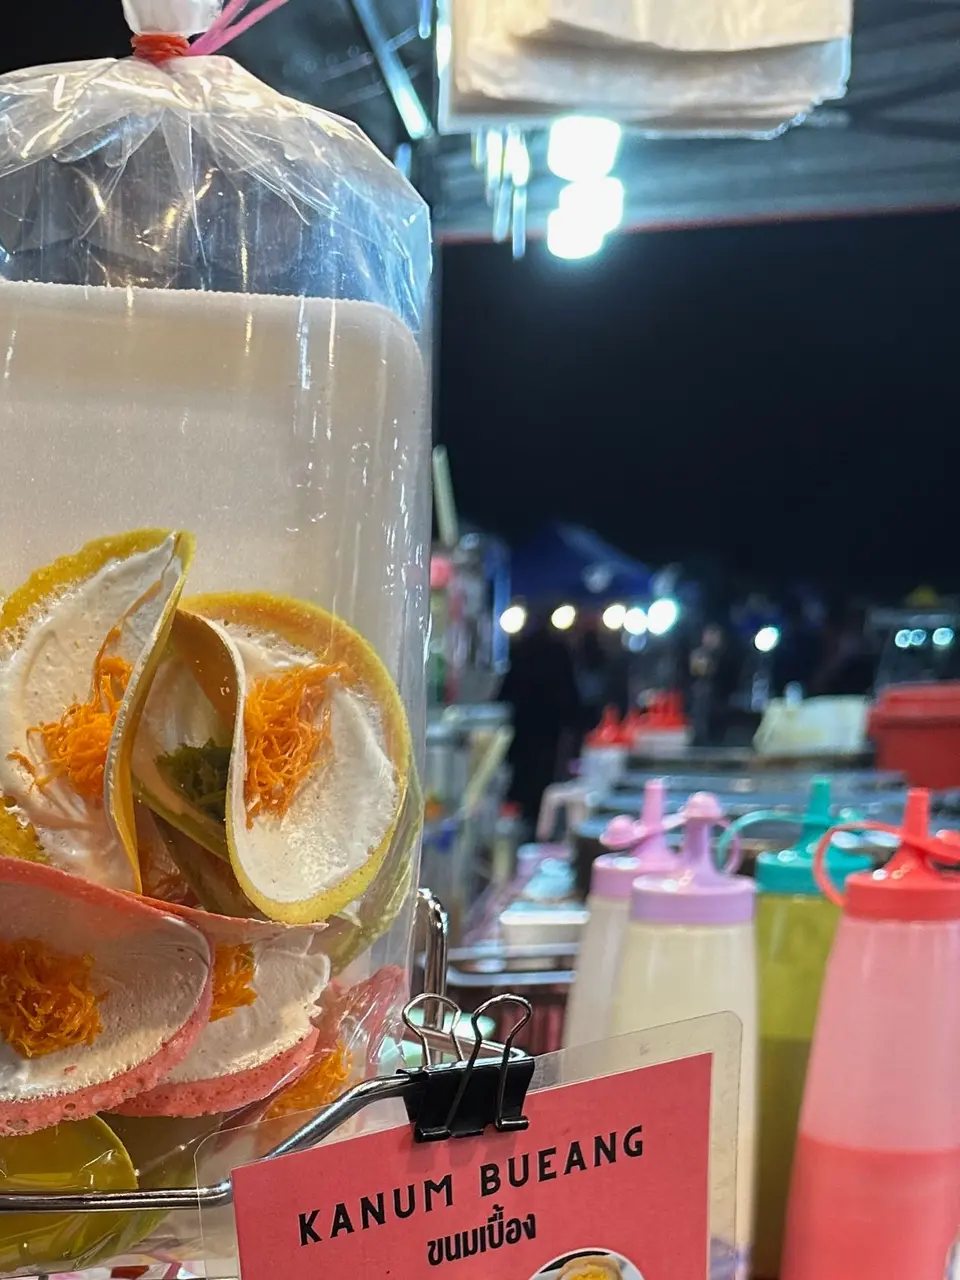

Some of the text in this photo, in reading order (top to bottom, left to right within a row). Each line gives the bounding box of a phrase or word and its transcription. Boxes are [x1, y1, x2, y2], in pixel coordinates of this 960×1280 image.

[298, 1124, 645, 1247] KANUM BUEANG
[426, 1203, 537, 1267] ขนมเบื้อง
